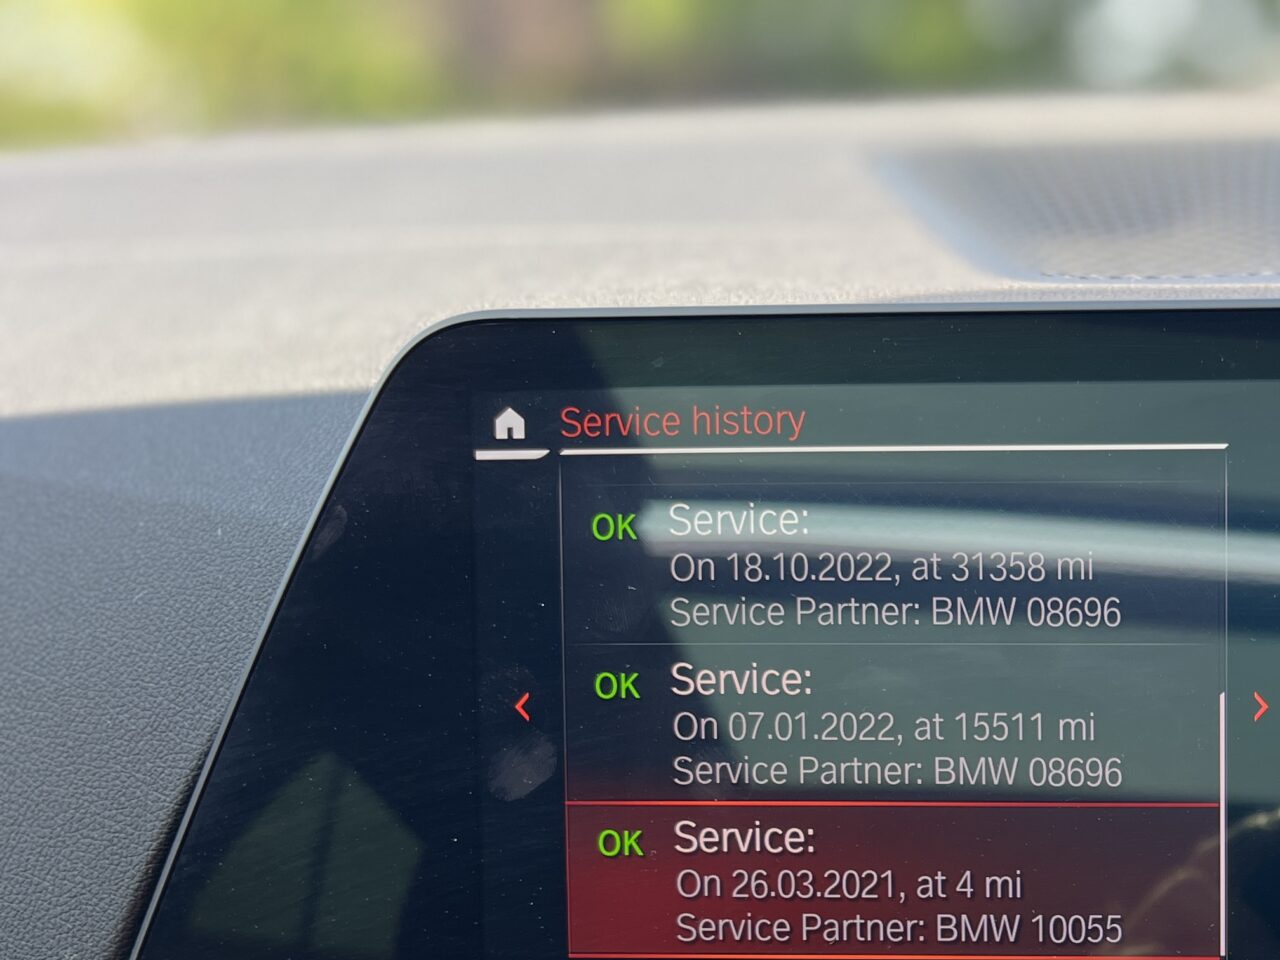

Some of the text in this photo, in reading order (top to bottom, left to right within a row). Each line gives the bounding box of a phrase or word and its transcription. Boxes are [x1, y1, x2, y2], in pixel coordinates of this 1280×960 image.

[560, 406, 806, 440] Service history
[591, 513, 638, 541] OK
[668, 504, 809, 536] Service:
[670, 551, 1094, 584] On 18.10.2022, at 31358 mi
[670, 598, 1121, 627] Service Partner: BMW 08696
[595, 672, 641, 699] OK
[671, 664, 812, 696] Service:
[672, 712, 1096, 744] On 07.01.2022, at 15511 mi
[672, 757, 1122, 787] Service Partner: BMW 08696
[598, 830, 644, 857] OK
[673, 821, 814, 852] Service:
[676, 869, 1022, 902] On 26.03.2021, at 4 mi
[676, 913, 1122, 944] Service Partner: BMW 10055
